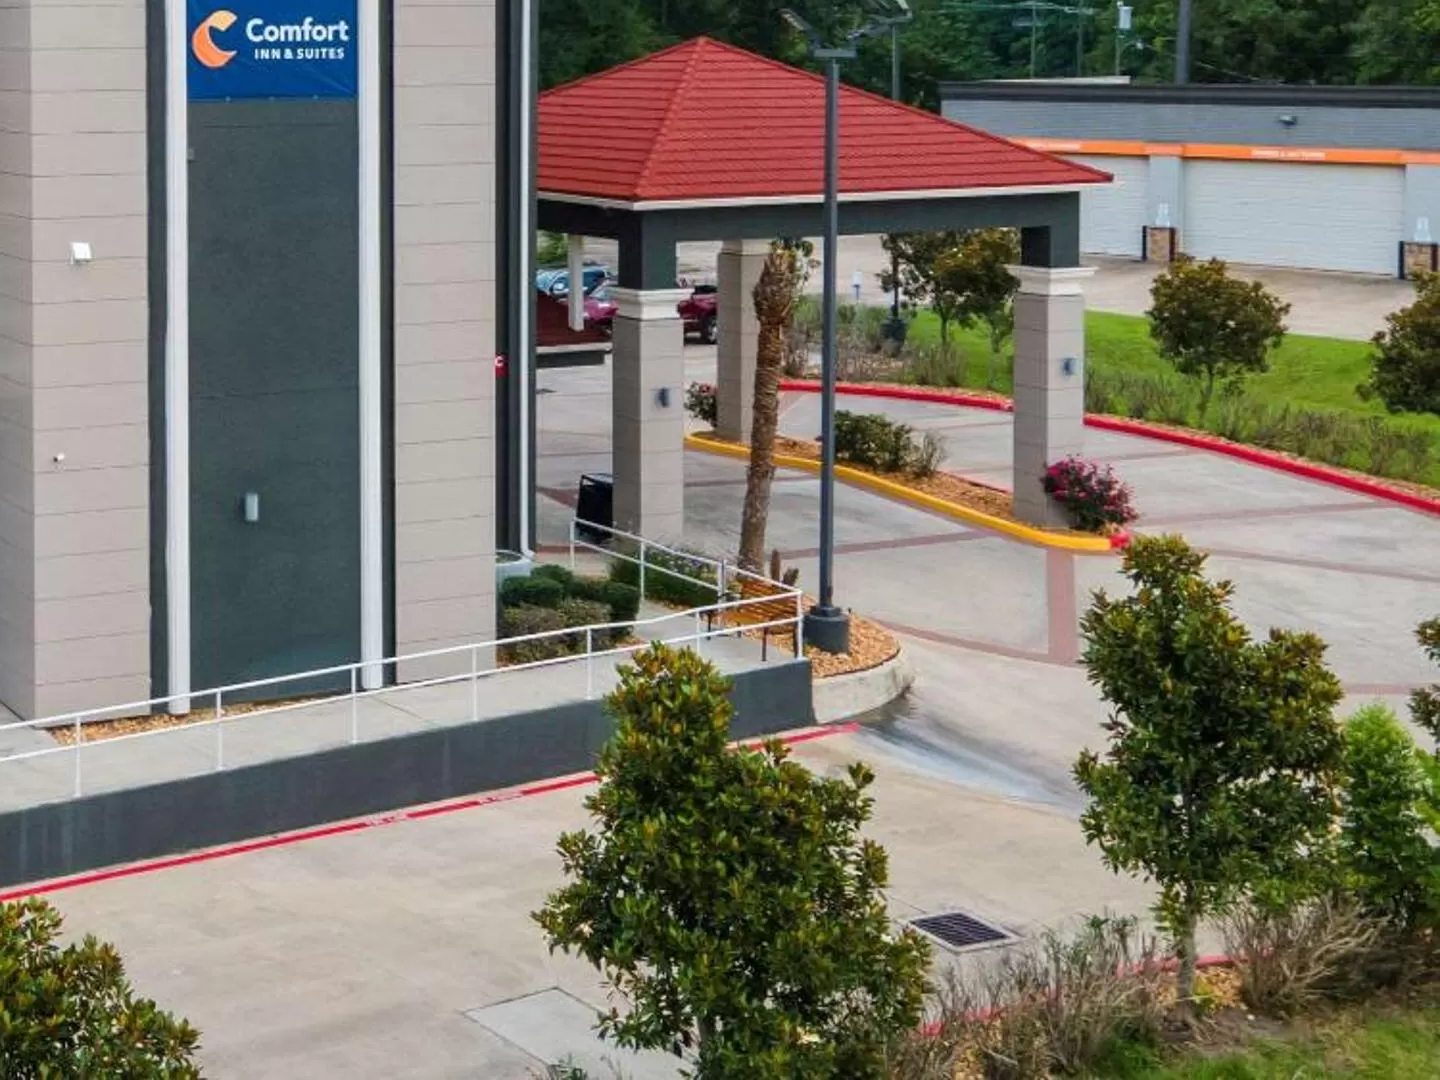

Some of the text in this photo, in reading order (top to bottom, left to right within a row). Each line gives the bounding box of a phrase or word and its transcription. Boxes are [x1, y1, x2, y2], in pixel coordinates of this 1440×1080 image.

[245, 16, 349, 42] Comfort
[254, 47, 345, 60] INN & SUITES
